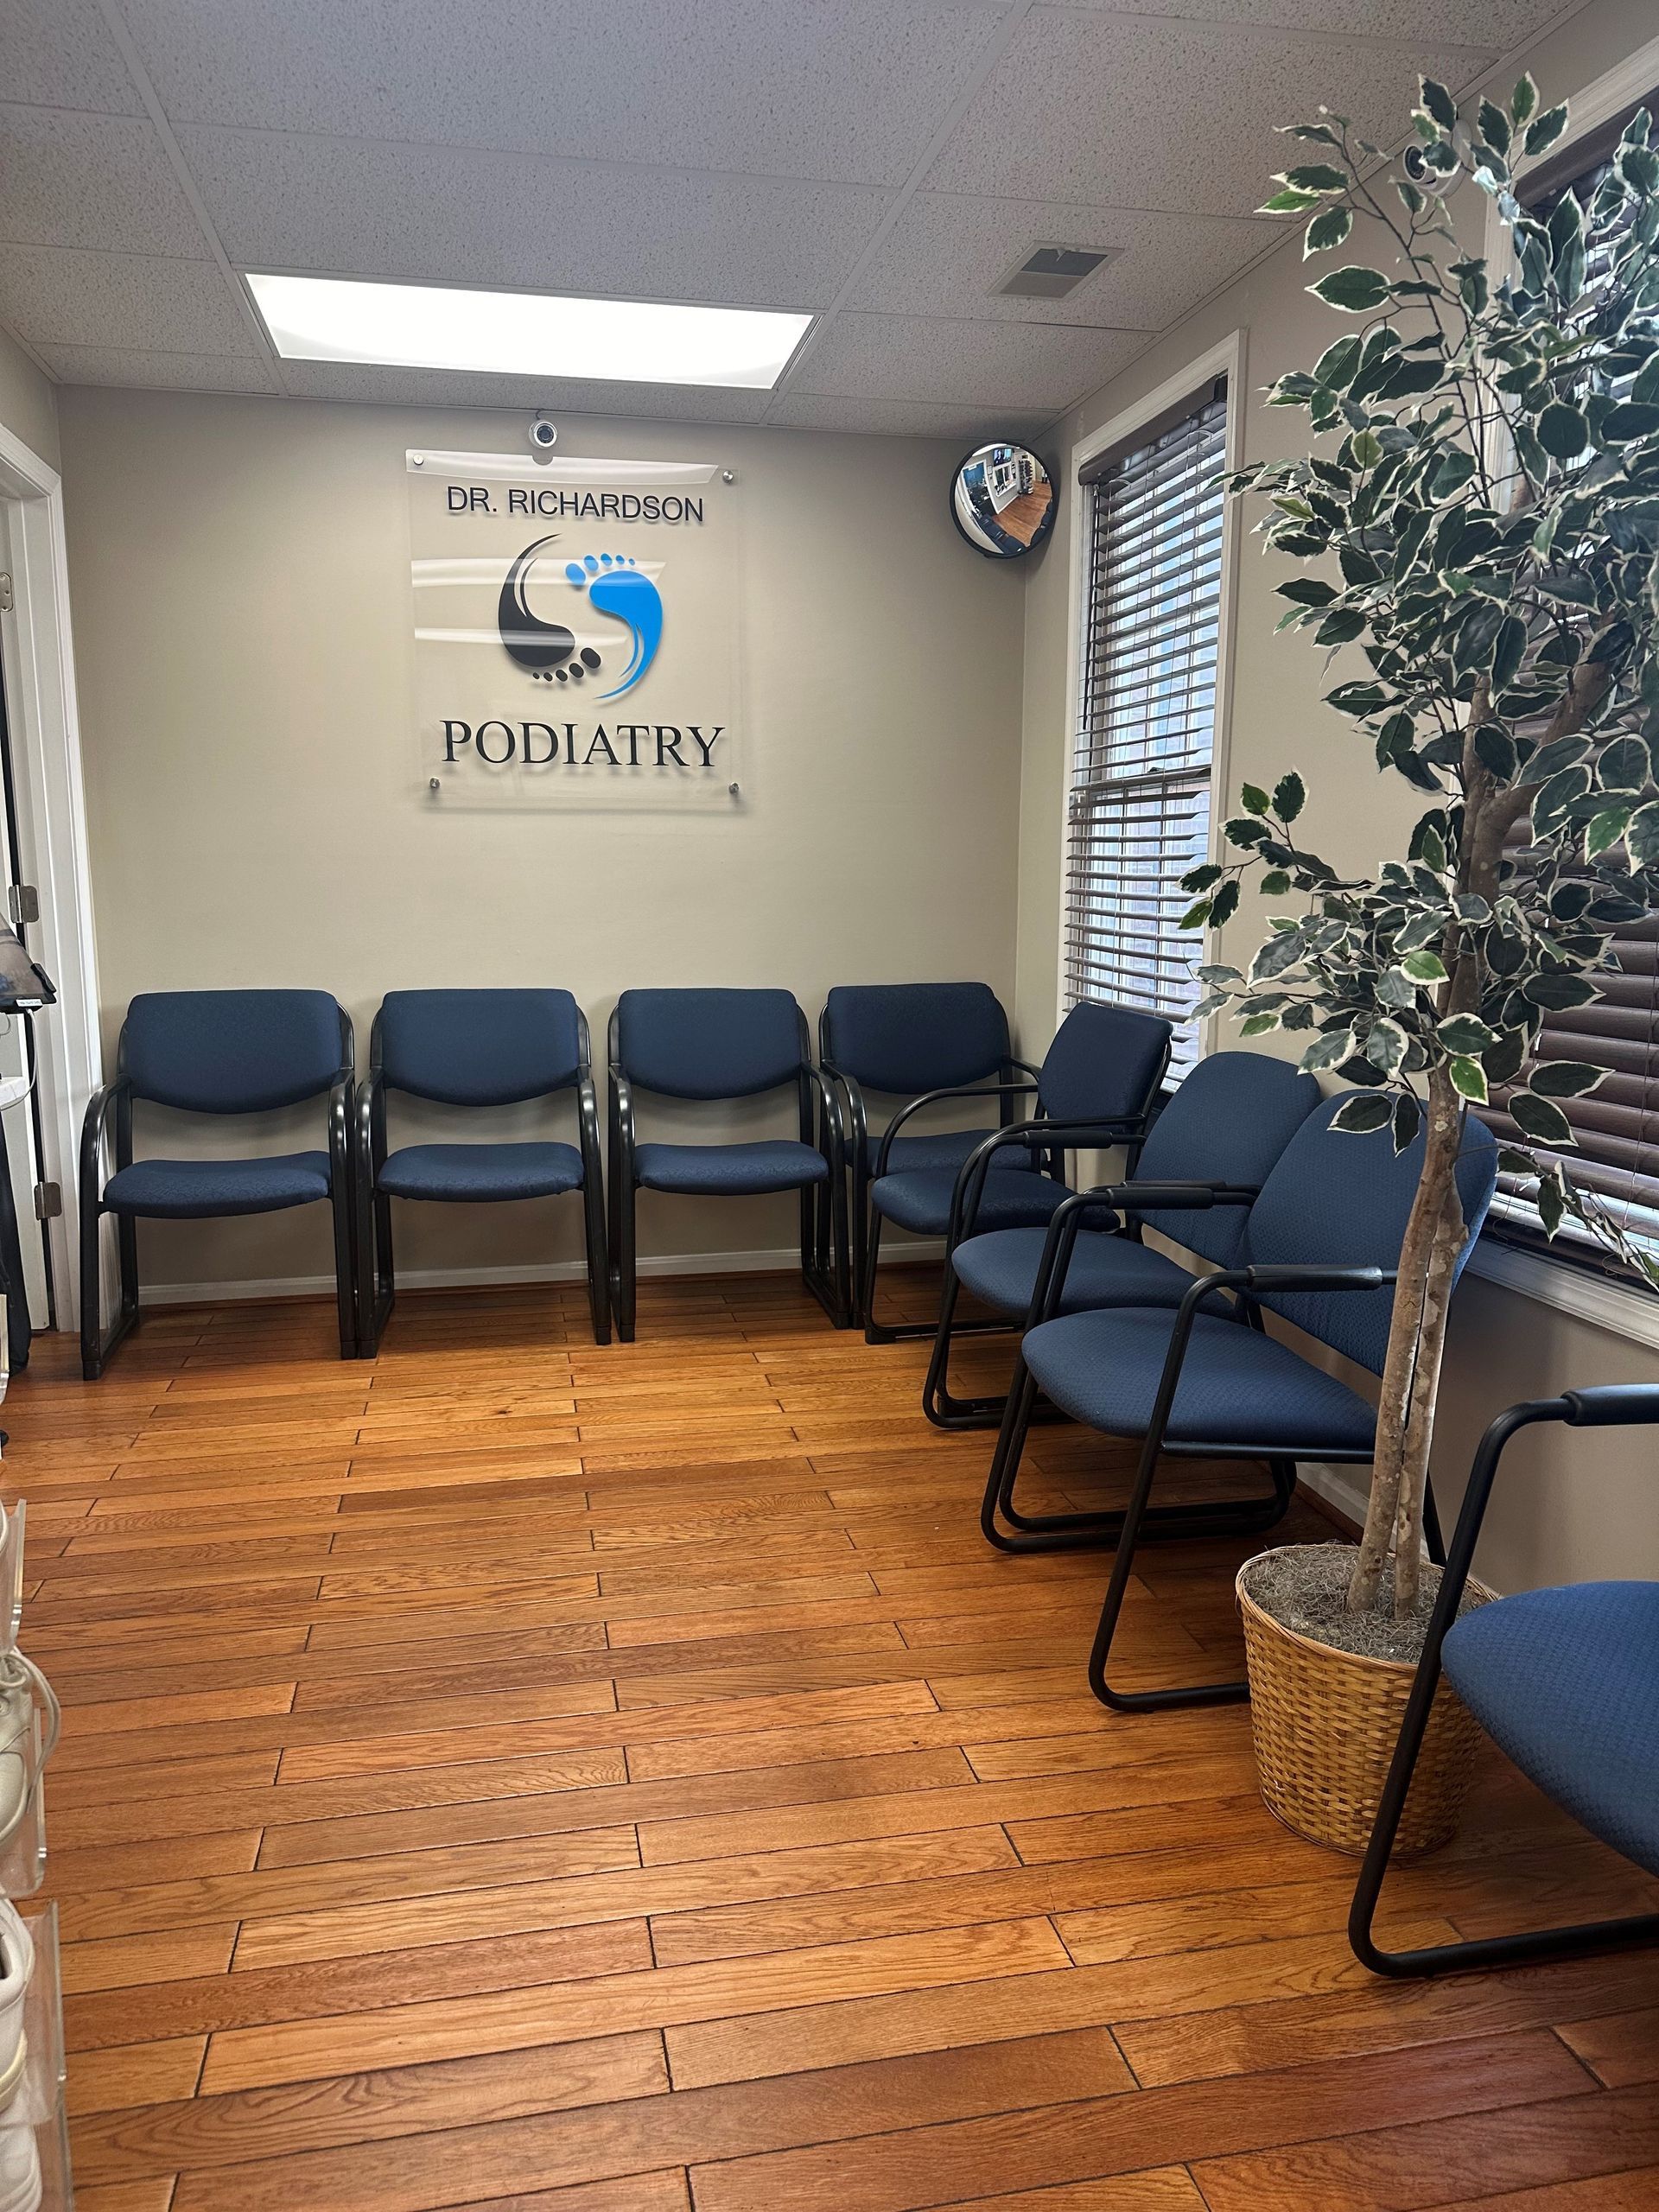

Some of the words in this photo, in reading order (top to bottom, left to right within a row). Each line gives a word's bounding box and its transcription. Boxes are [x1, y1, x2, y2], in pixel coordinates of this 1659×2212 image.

[448, 486, 497, 512] DR.
[508, 488, 703, 522] RICHARDSON
[440, 720, 726, 767] PODIATRY
